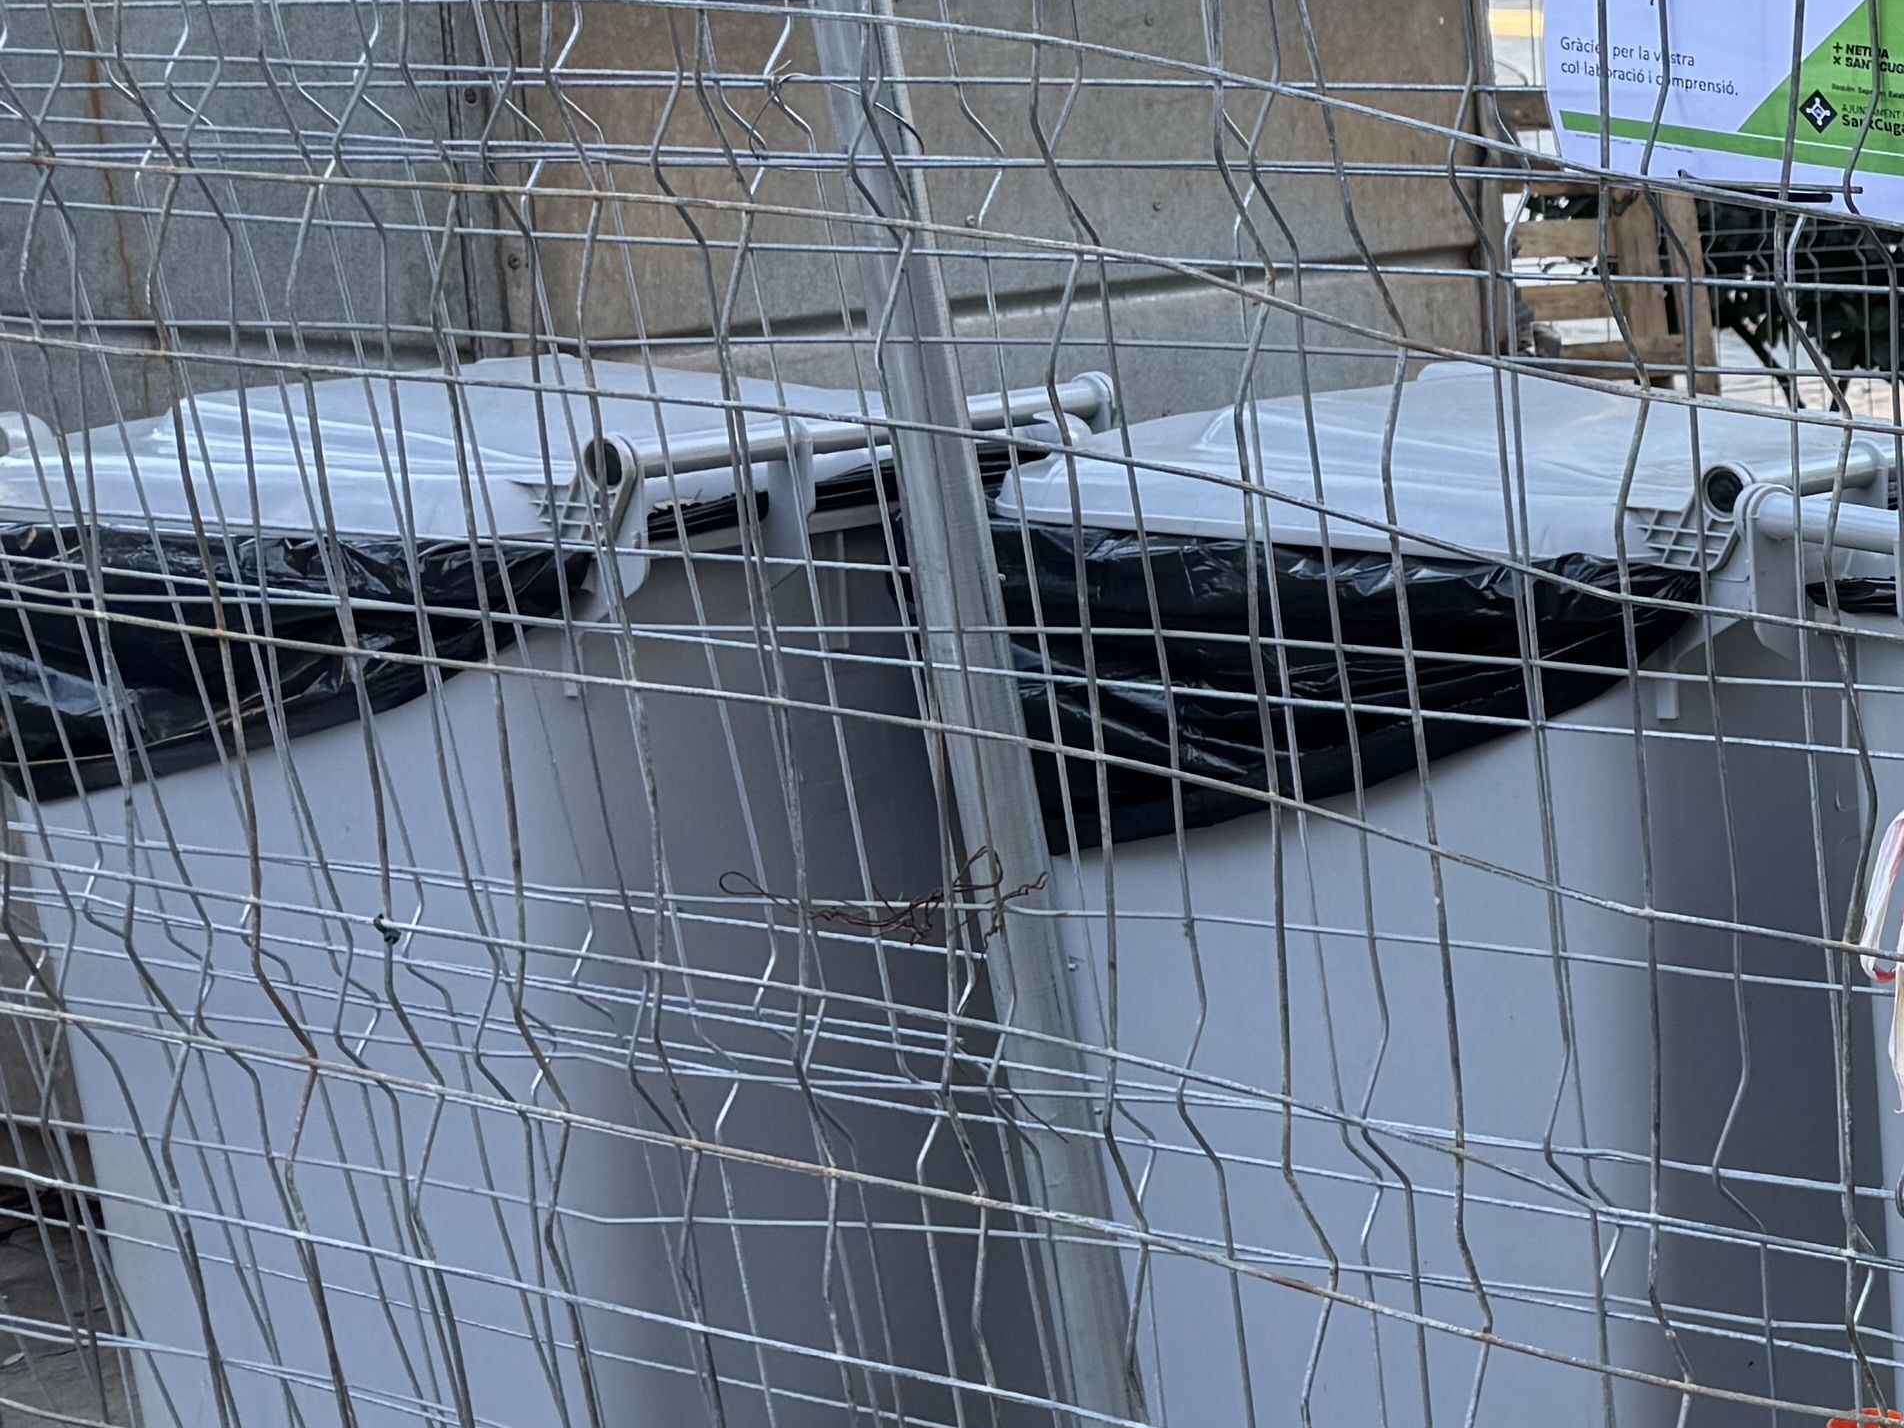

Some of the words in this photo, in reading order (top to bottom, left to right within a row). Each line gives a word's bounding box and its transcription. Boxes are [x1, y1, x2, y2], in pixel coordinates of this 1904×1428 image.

[1560, 36, 1604, 56] Gràcie
[1612, 45, 1634, 60] per
[1639, 45, 1650, 61] la
[1654, 52, 1695, 67] vstra
[1656, 76, 1739, 97] cmprensió.
